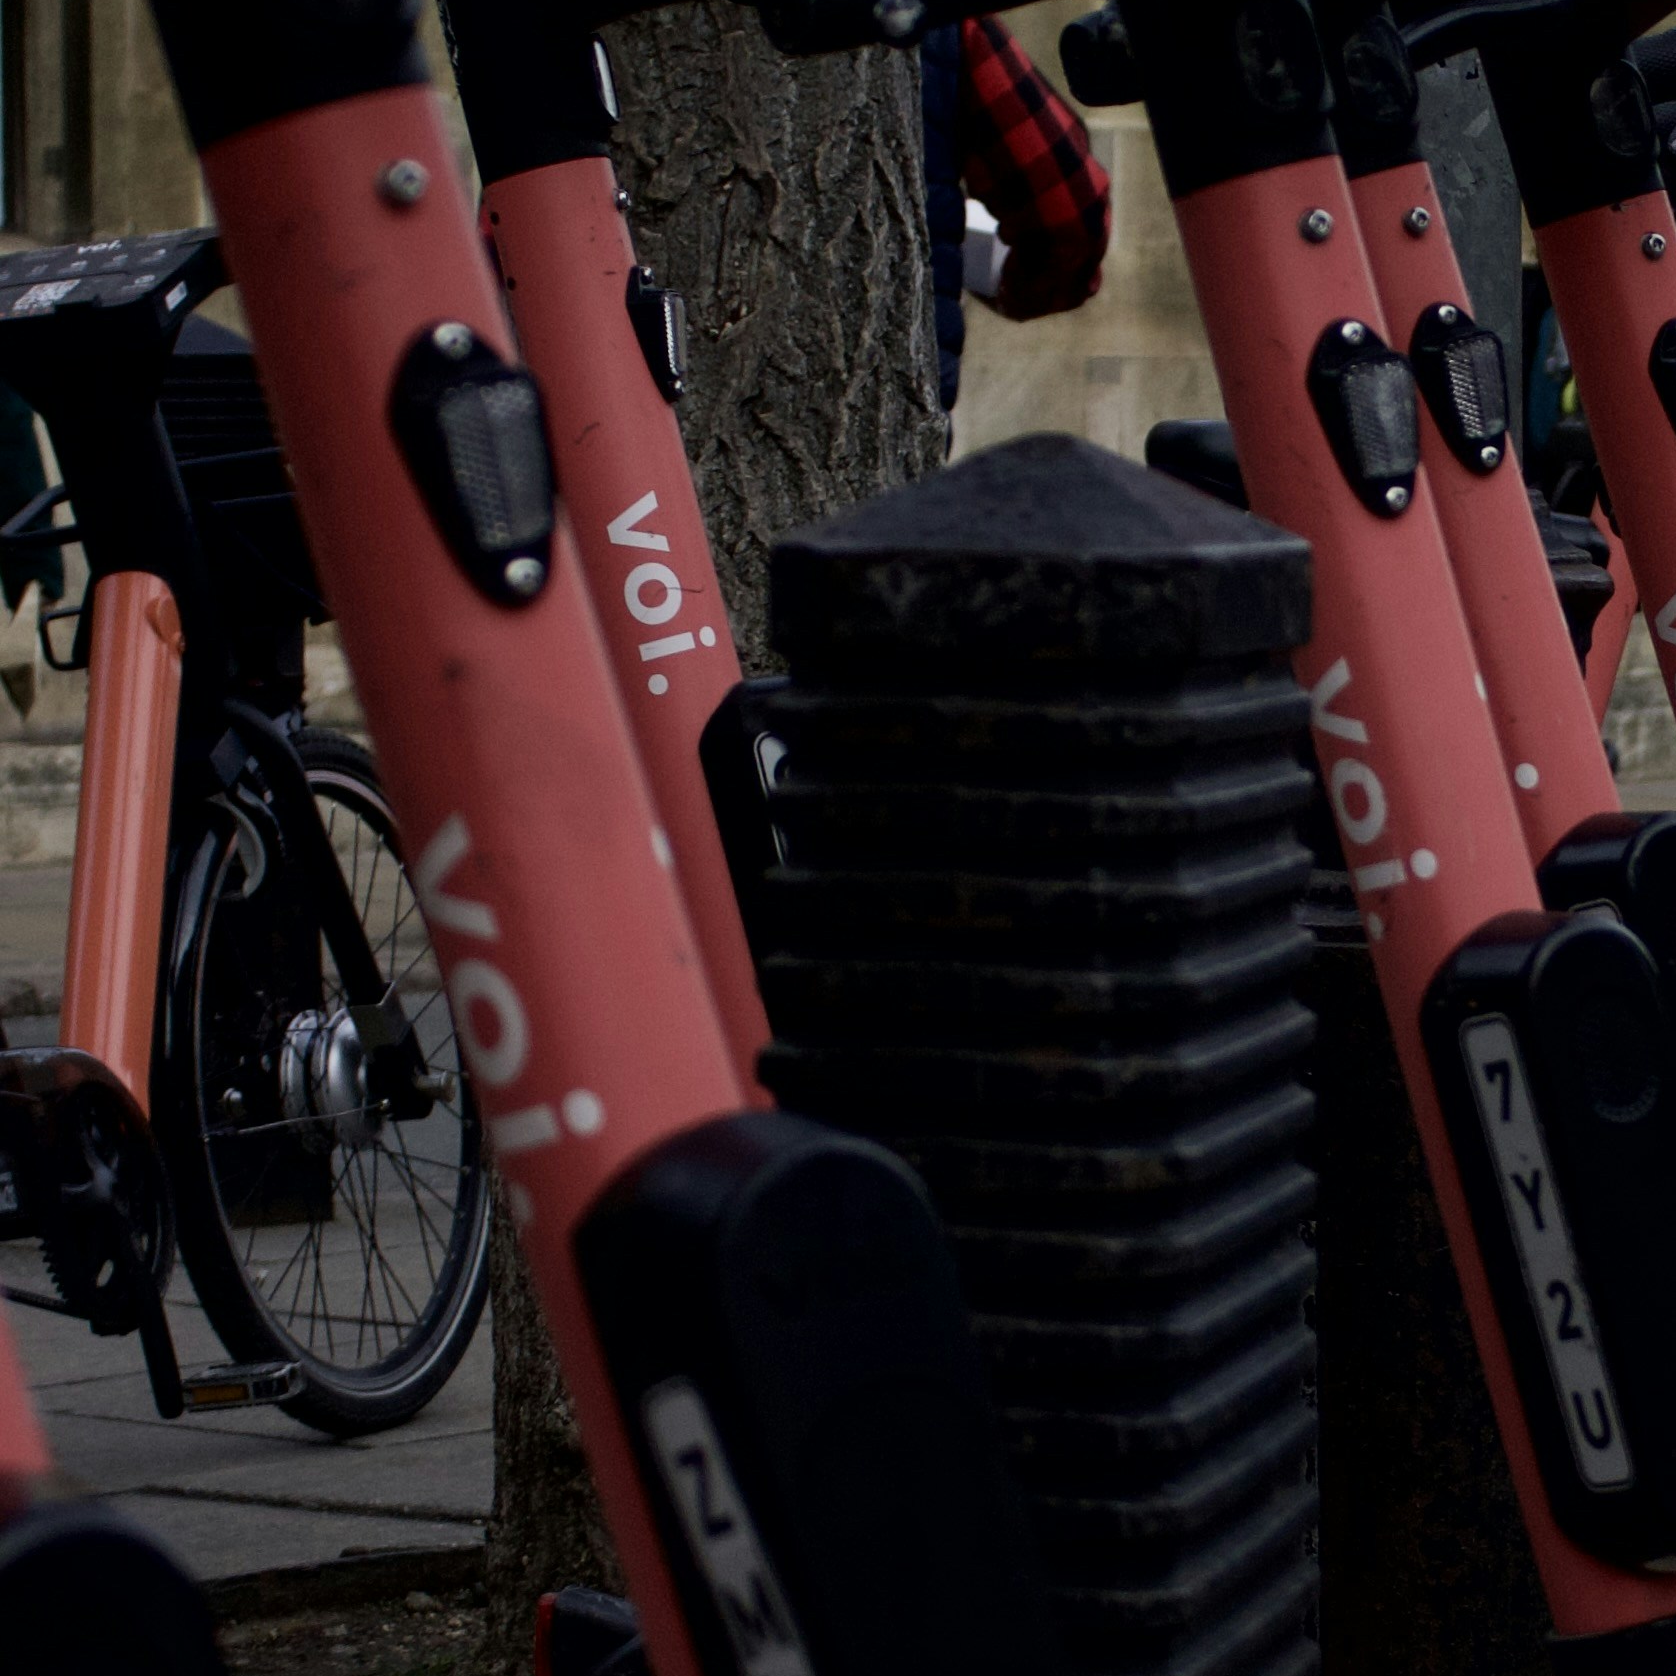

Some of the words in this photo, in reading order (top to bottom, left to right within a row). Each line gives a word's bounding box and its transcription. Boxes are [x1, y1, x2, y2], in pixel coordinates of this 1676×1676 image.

[606, 490, 716, 697] voi.
[1310, 656, 1438, 942] voi.
[414, 810, 606, 1226] voi.
[1485, 1060, 1612, 1449] 7Y2U
